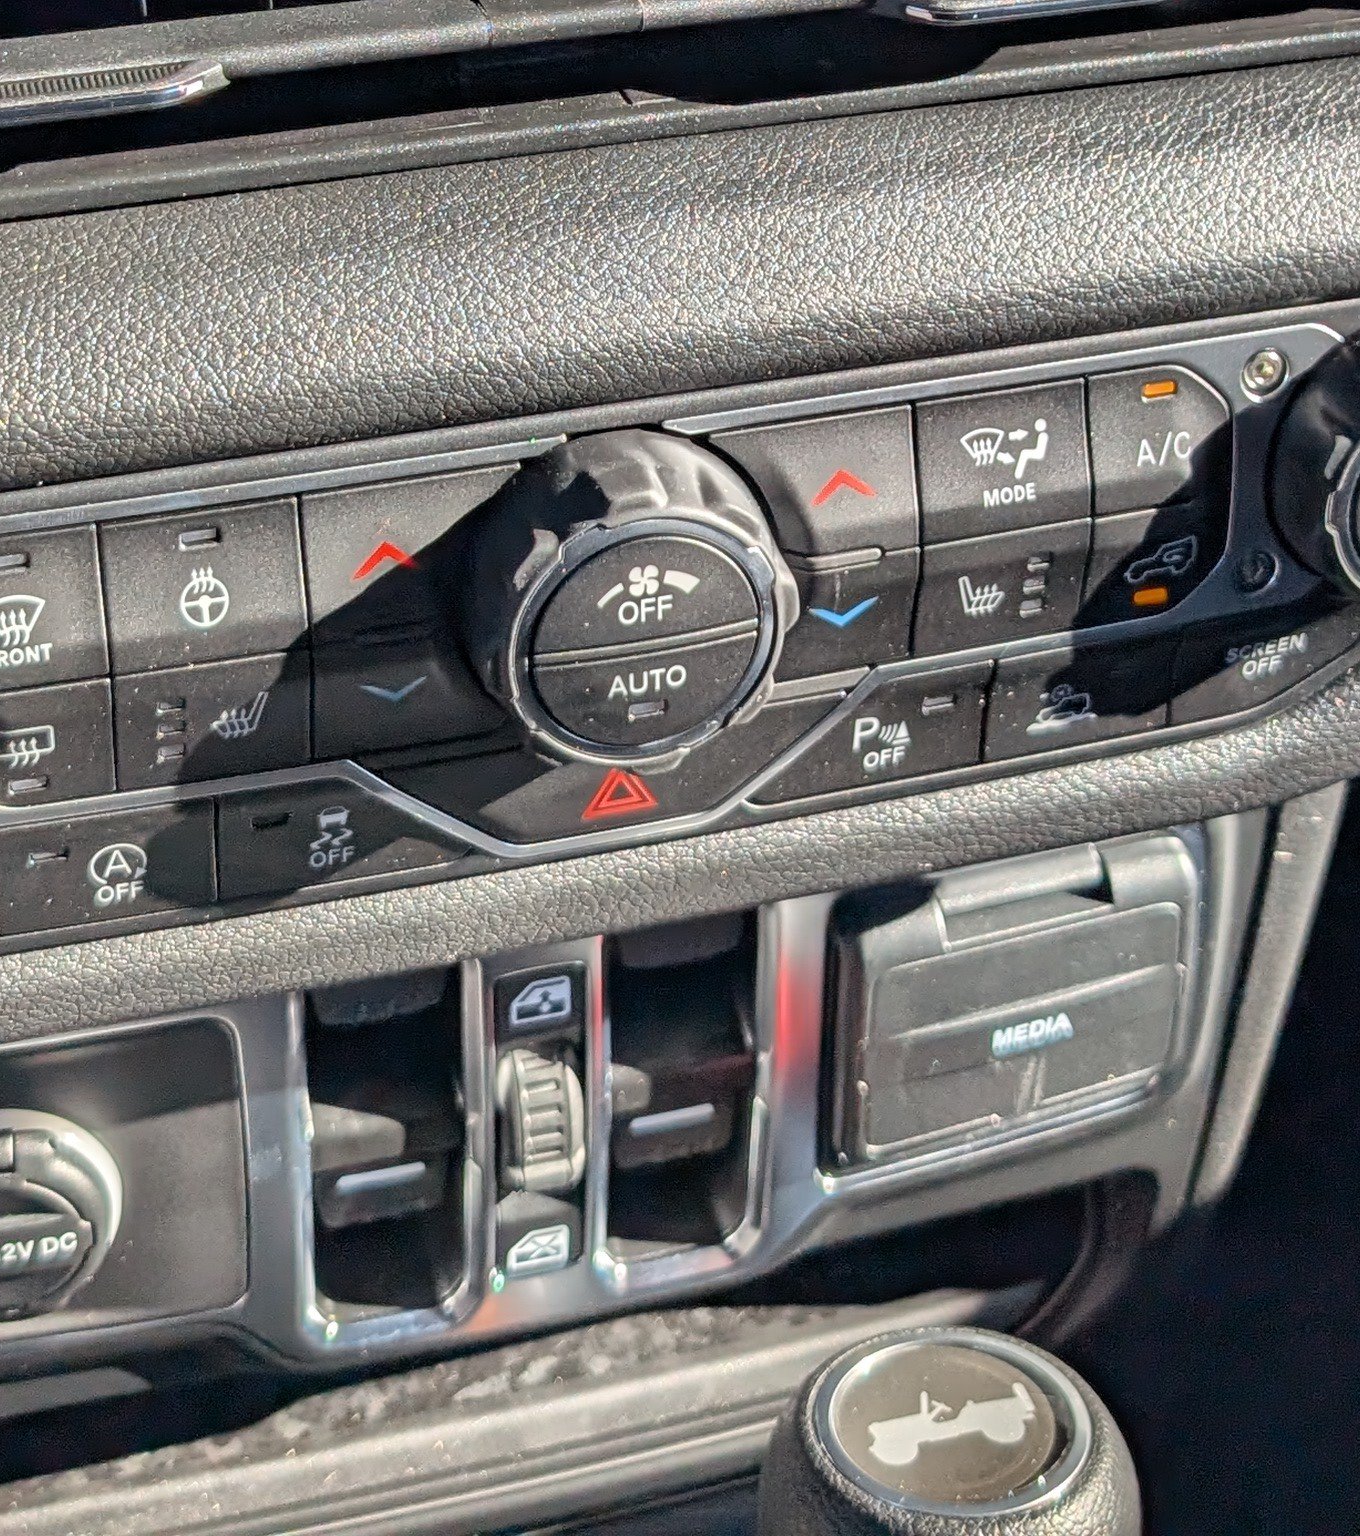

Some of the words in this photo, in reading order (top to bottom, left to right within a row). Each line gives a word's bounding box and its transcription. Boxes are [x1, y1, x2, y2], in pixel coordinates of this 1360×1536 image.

[1137, 429, 1192, 468] A/C
[983, 481, 1037, 507] MODE
[618, 595, 674, 624] OFF
[1225, 632, 1308, 664] SCREEN
[608, 664, 687, 699] AUTO
[1242, 654, 1282, 681] OFF
[862, 744, 906, 769] OFF
[309, 845, 354, 869] OFF
[95, 880, 144, 904] OFF
[992, 1013, 1073, 1056] MEDIA
[38, 1230, 79, 1259] DC
